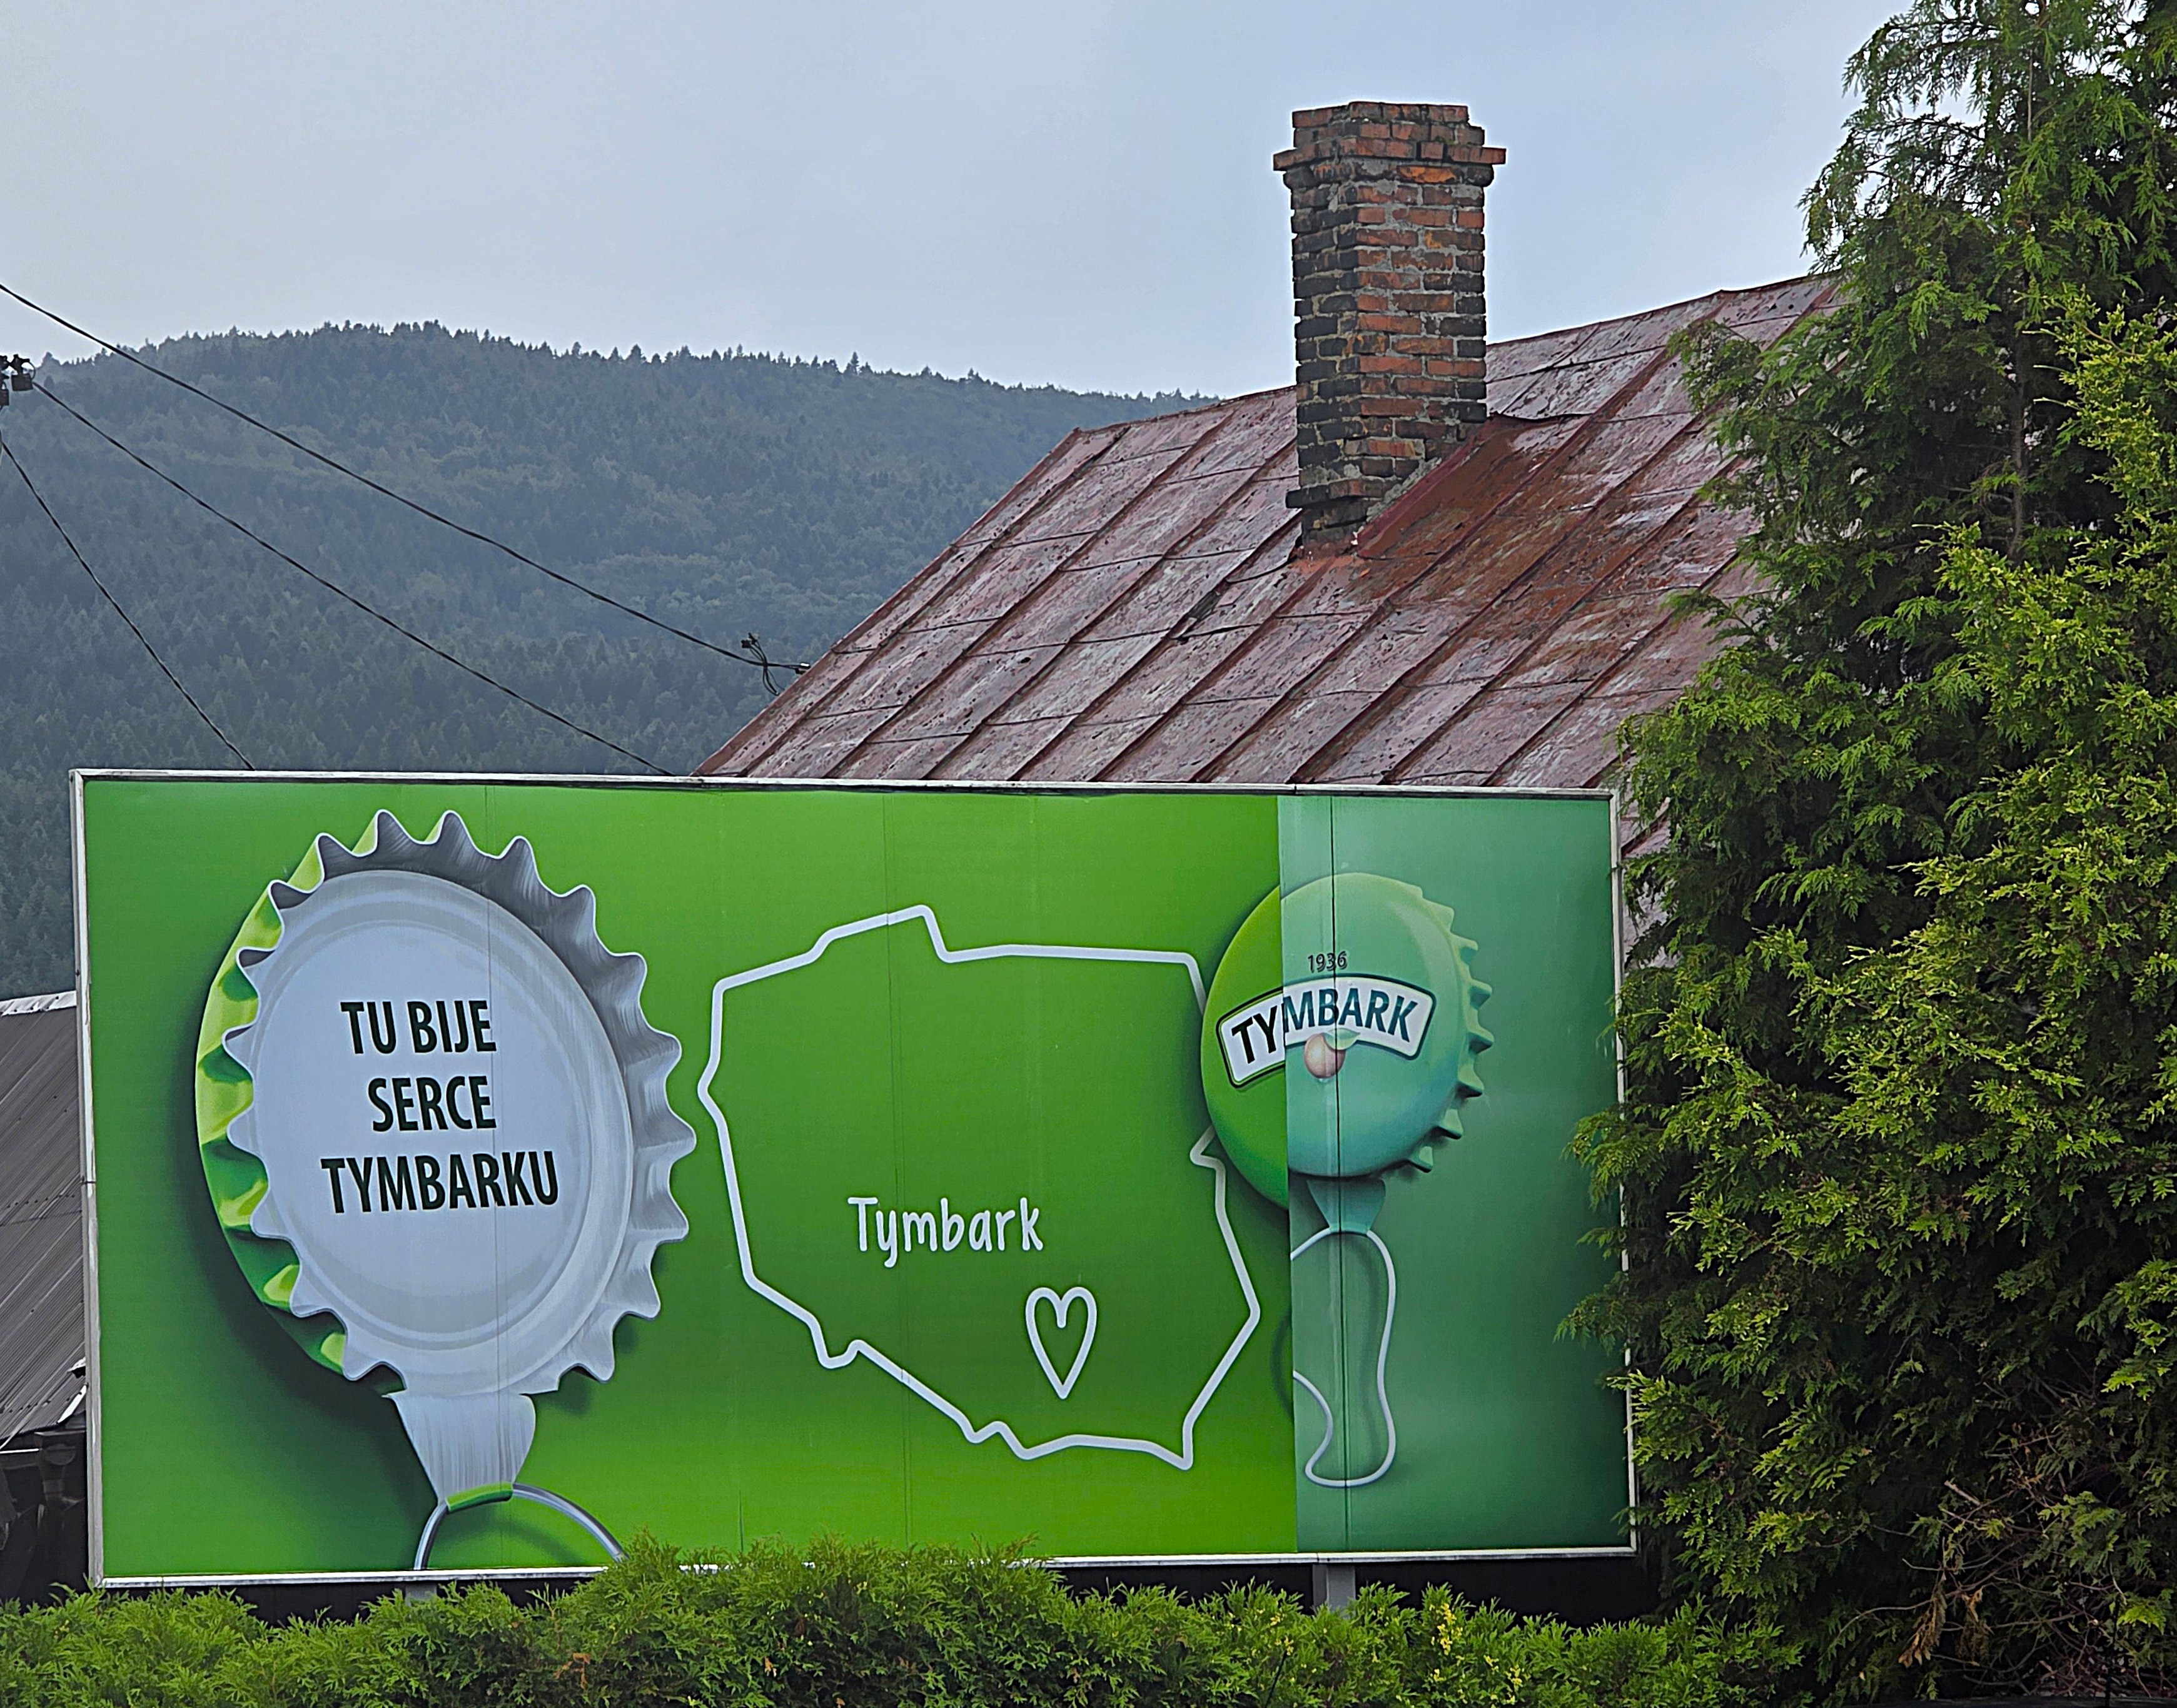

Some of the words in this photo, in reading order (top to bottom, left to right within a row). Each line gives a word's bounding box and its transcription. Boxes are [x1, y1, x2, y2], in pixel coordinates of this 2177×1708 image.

[1308, 951, 1348, 973] 1936
[340, 1001, 397, 1054] TU
[407, 1000, 497, 1054] BIJE
[1231, 987, 1418, 1064] TYMBARK
[368, 1075, 497, 1132] SERCE
[320, 1151, 558, 1214] TYMBARKU
[847, 1196, 1044, 1268] Tymbark
